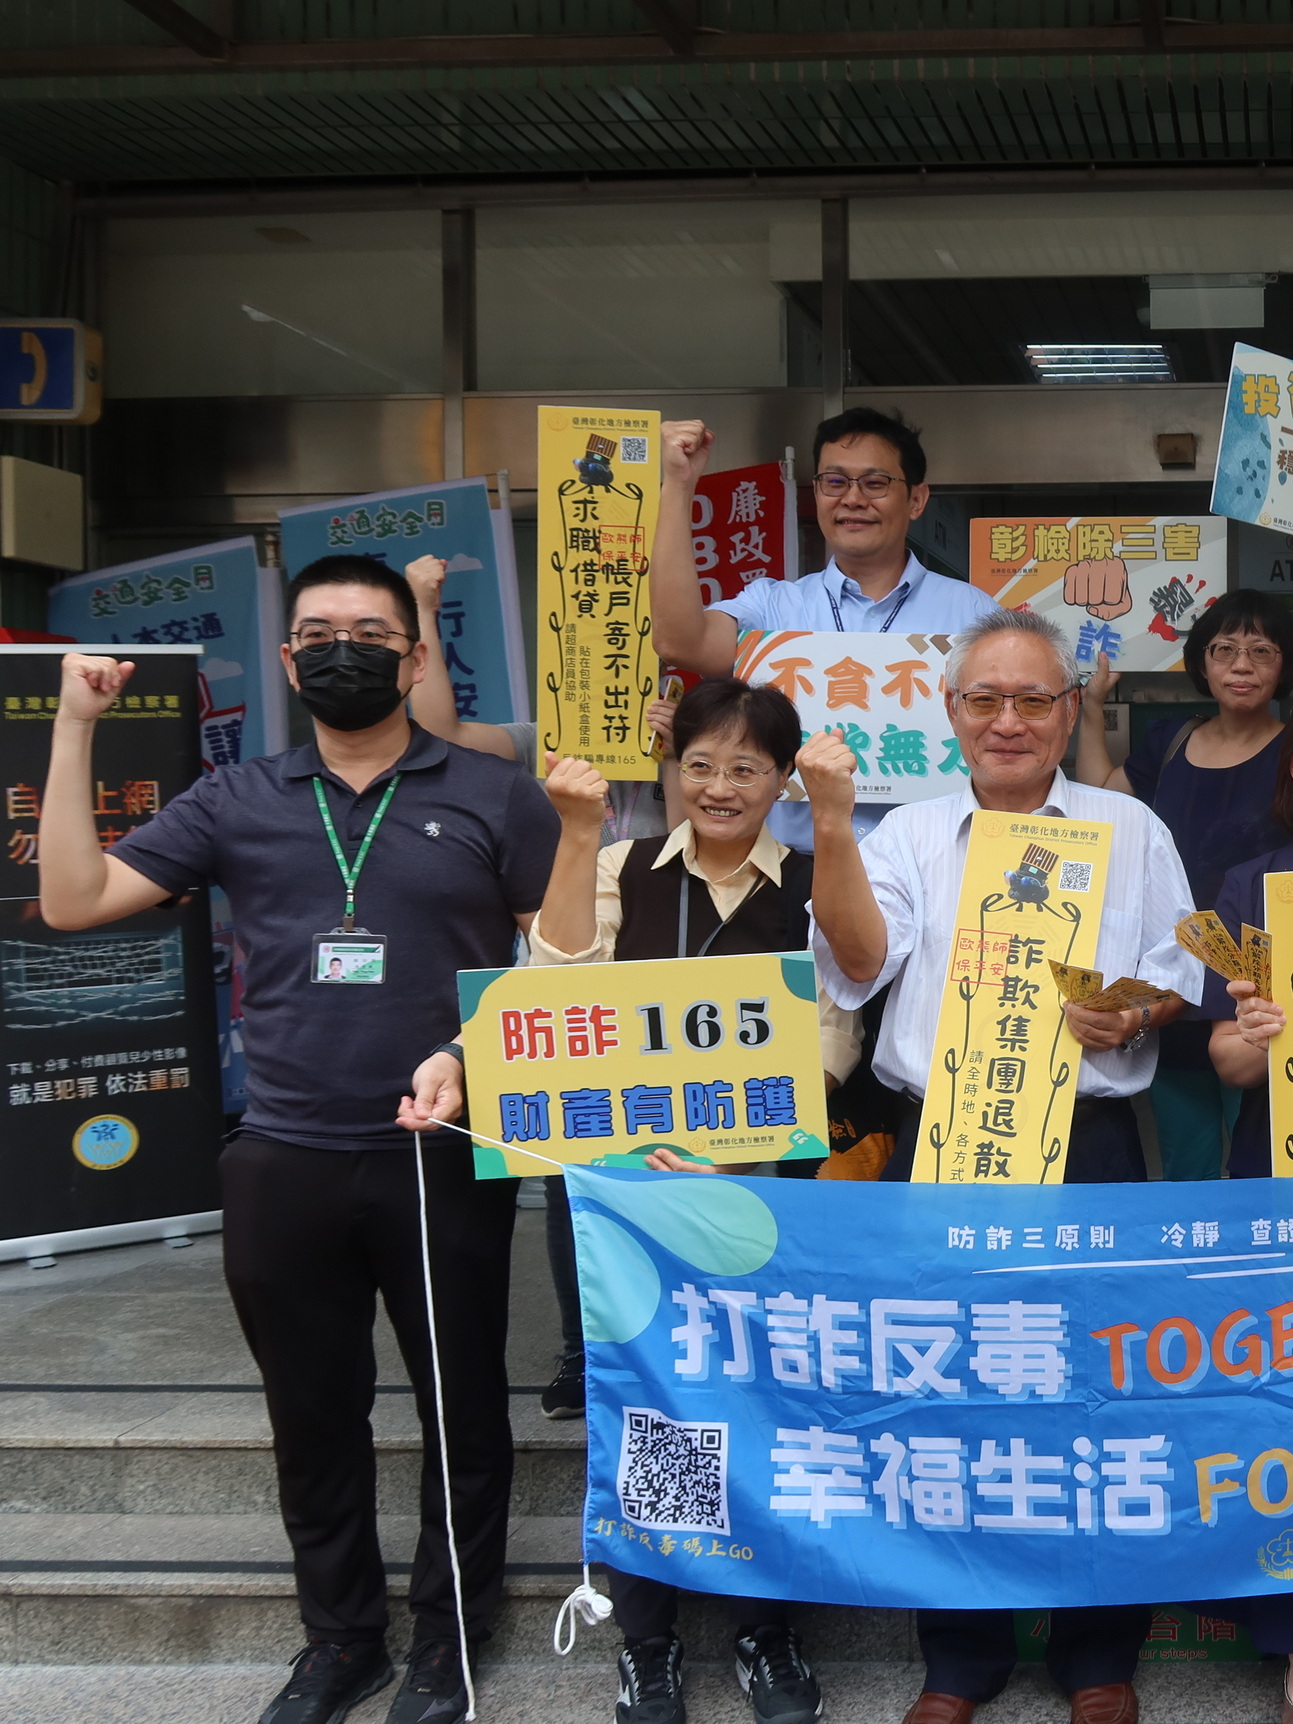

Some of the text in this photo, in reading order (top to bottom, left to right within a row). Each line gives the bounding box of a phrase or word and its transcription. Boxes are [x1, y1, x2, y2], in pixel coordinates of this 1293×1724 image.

[328, 500, 446, 547] 交通安全月
[989, 523, 1201, 563] 彰檢除三害
[111, 612, 225, 644] 本交通
[1074, 619, 1122, 663] 詐
[601, 559, 633, 744] 帳戶寄不出符
[767, 656, 950, 712] 不貪不
[6, 779, 161, 820] 自上網
[1009, 823, 1099, 841] 臺灣彰化地方檢察署
[959, 936, 1008, 954] 歐熊師
[955, 958, 1005, 977] 保平安
[500, 996, 774, 1062] 防詐 165
[499, 1076, 797, 1143] 財產有防護
[947, 1225, 1115, 1251] 防詐三原則
[1159, 1220, 1220, 1249] 冷靜
[670, 1282, 1071, 1398] 打詐反毒
[769, 1425, 1172, 1535] 幸福生活
[594, 1517, 754, 1561] 打詐反毒碼上GO
[1159, 1646, 1208, 1660] steps
